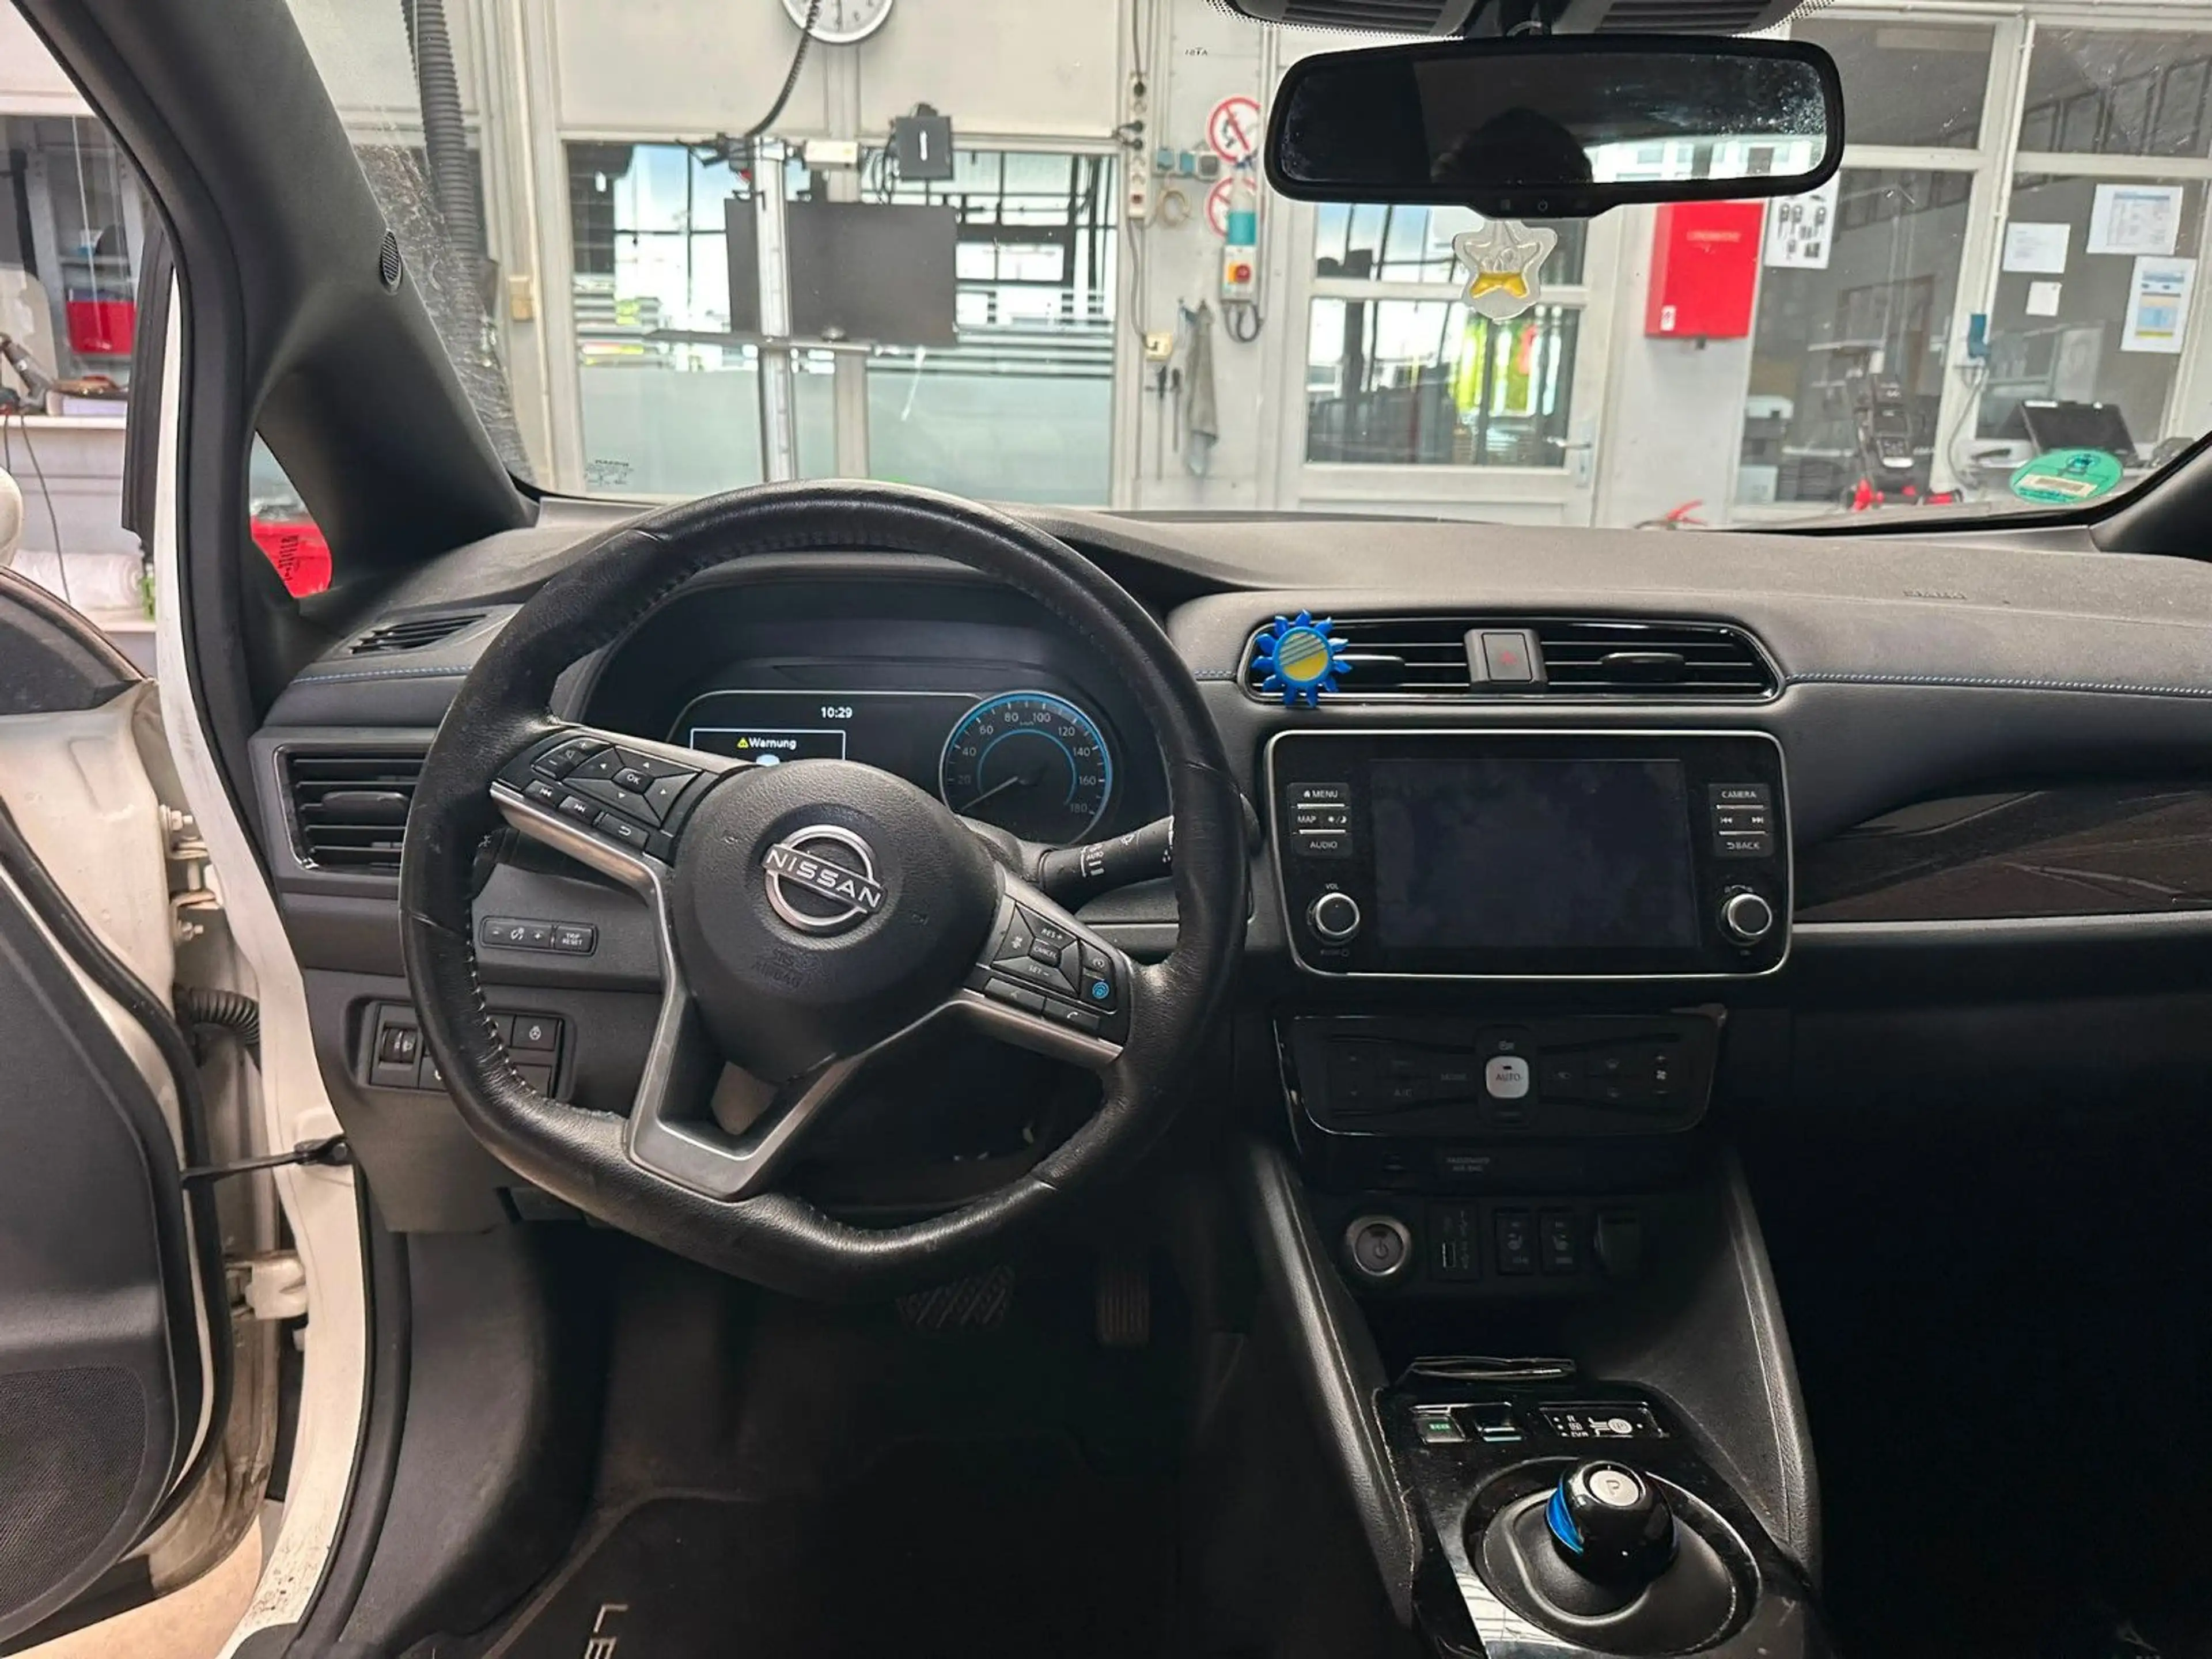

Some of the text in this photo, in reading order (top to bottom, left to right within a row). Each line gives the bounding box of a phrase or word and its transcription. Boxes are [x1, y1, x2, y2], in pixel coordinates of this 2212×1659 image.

[820, 707, 853, 718] 10:29
[1004, 712, 1018, 722] 80
[1033, 712, 1051, 722] 100
[979, 725, 994, 734] 60
[1058, 726, 1075, 736] 120
[749, 737, 797, 750] Warnung
[962, 747, 976, 756] 40
[1073, 747, 1090, 756] 140
[627, 774, 641, 785] OK
[958, 775, 971, 785] 20
[1079, 775, 1096, 785] 160
[1312, 790, 1338, 798] MENU
[1070, 803, 1088, 813] 180
[1298, 815, 1317, 823] MAP
[1309, 840, 1338, 849] AUDIO
[1735, 842, 1760, 850] BACK
[766, 849, 881, 908] NISSAN
[1496, 1073, 1521, 1081] AUTO
[1605, 1480, 1620, 1495] P
